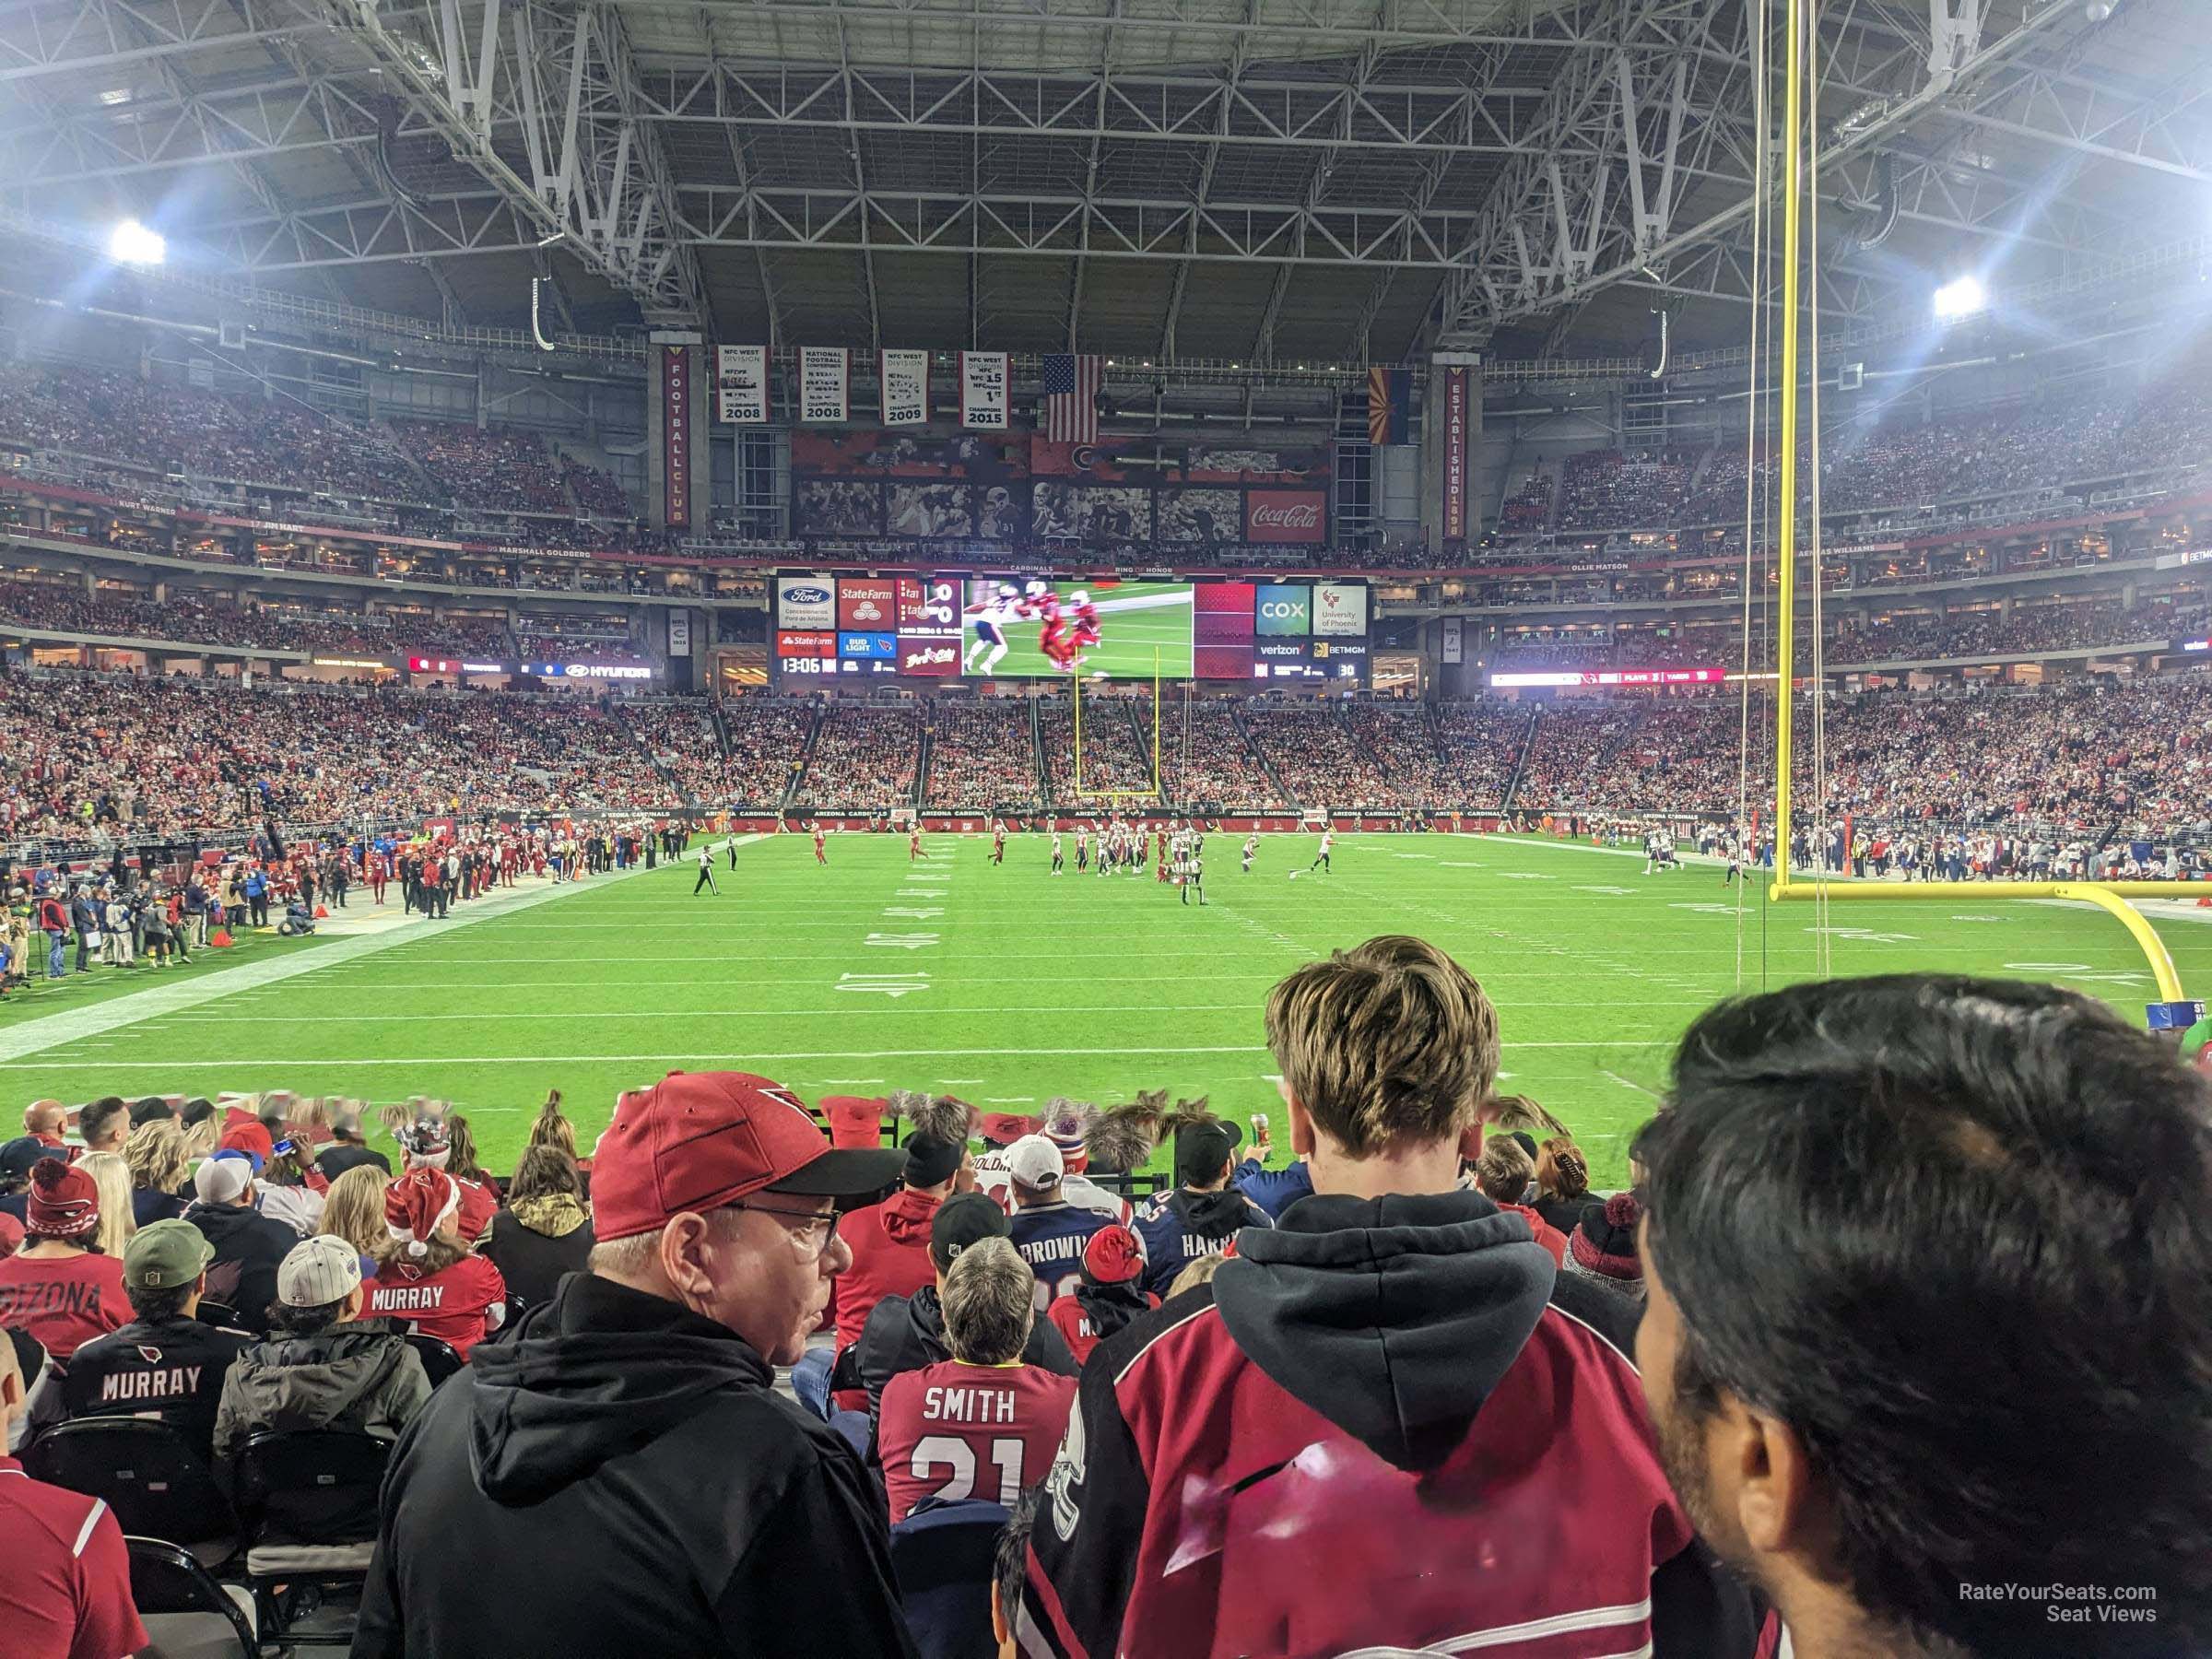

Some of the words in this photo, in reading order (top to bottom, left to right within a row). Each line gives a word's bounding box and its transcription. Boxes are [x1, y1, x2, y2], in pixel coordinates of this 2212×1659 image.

[671, 365, 682, 467] FOOTBALL
[725, 408, 760, 418] 2008
[806, 407, 841, 418] 2008
[888, 409, 922, 421] 2009
[968, 413, 1003, 424] 2015
[1451, 384, 1461, 494] ESTABLISHED
[673, 471, 682, 521] CLUB
[142, 504, 176, 516] WARNER
[500, 547, 546, 556] MARSHALL
[547, 549, 591, 559] GOLDBERG
[1833, 545, 1875, 554] WILLIAMS
[791, 589, 822, 602] Ford
[1261, 602, 1305, 618] COX
[1322, 611, 1357, 621] University
[1260, 644, 1300, 655] verizon
[1329, 646, 1366, 654] BETMGM
[371, 1286, 444, 1311] MURRAY
[102, 1366, 202, 1401] MURRAY
[923, 1387, 1016, 1423] SMITH
[906, 1435, 1025, 1517] 21
